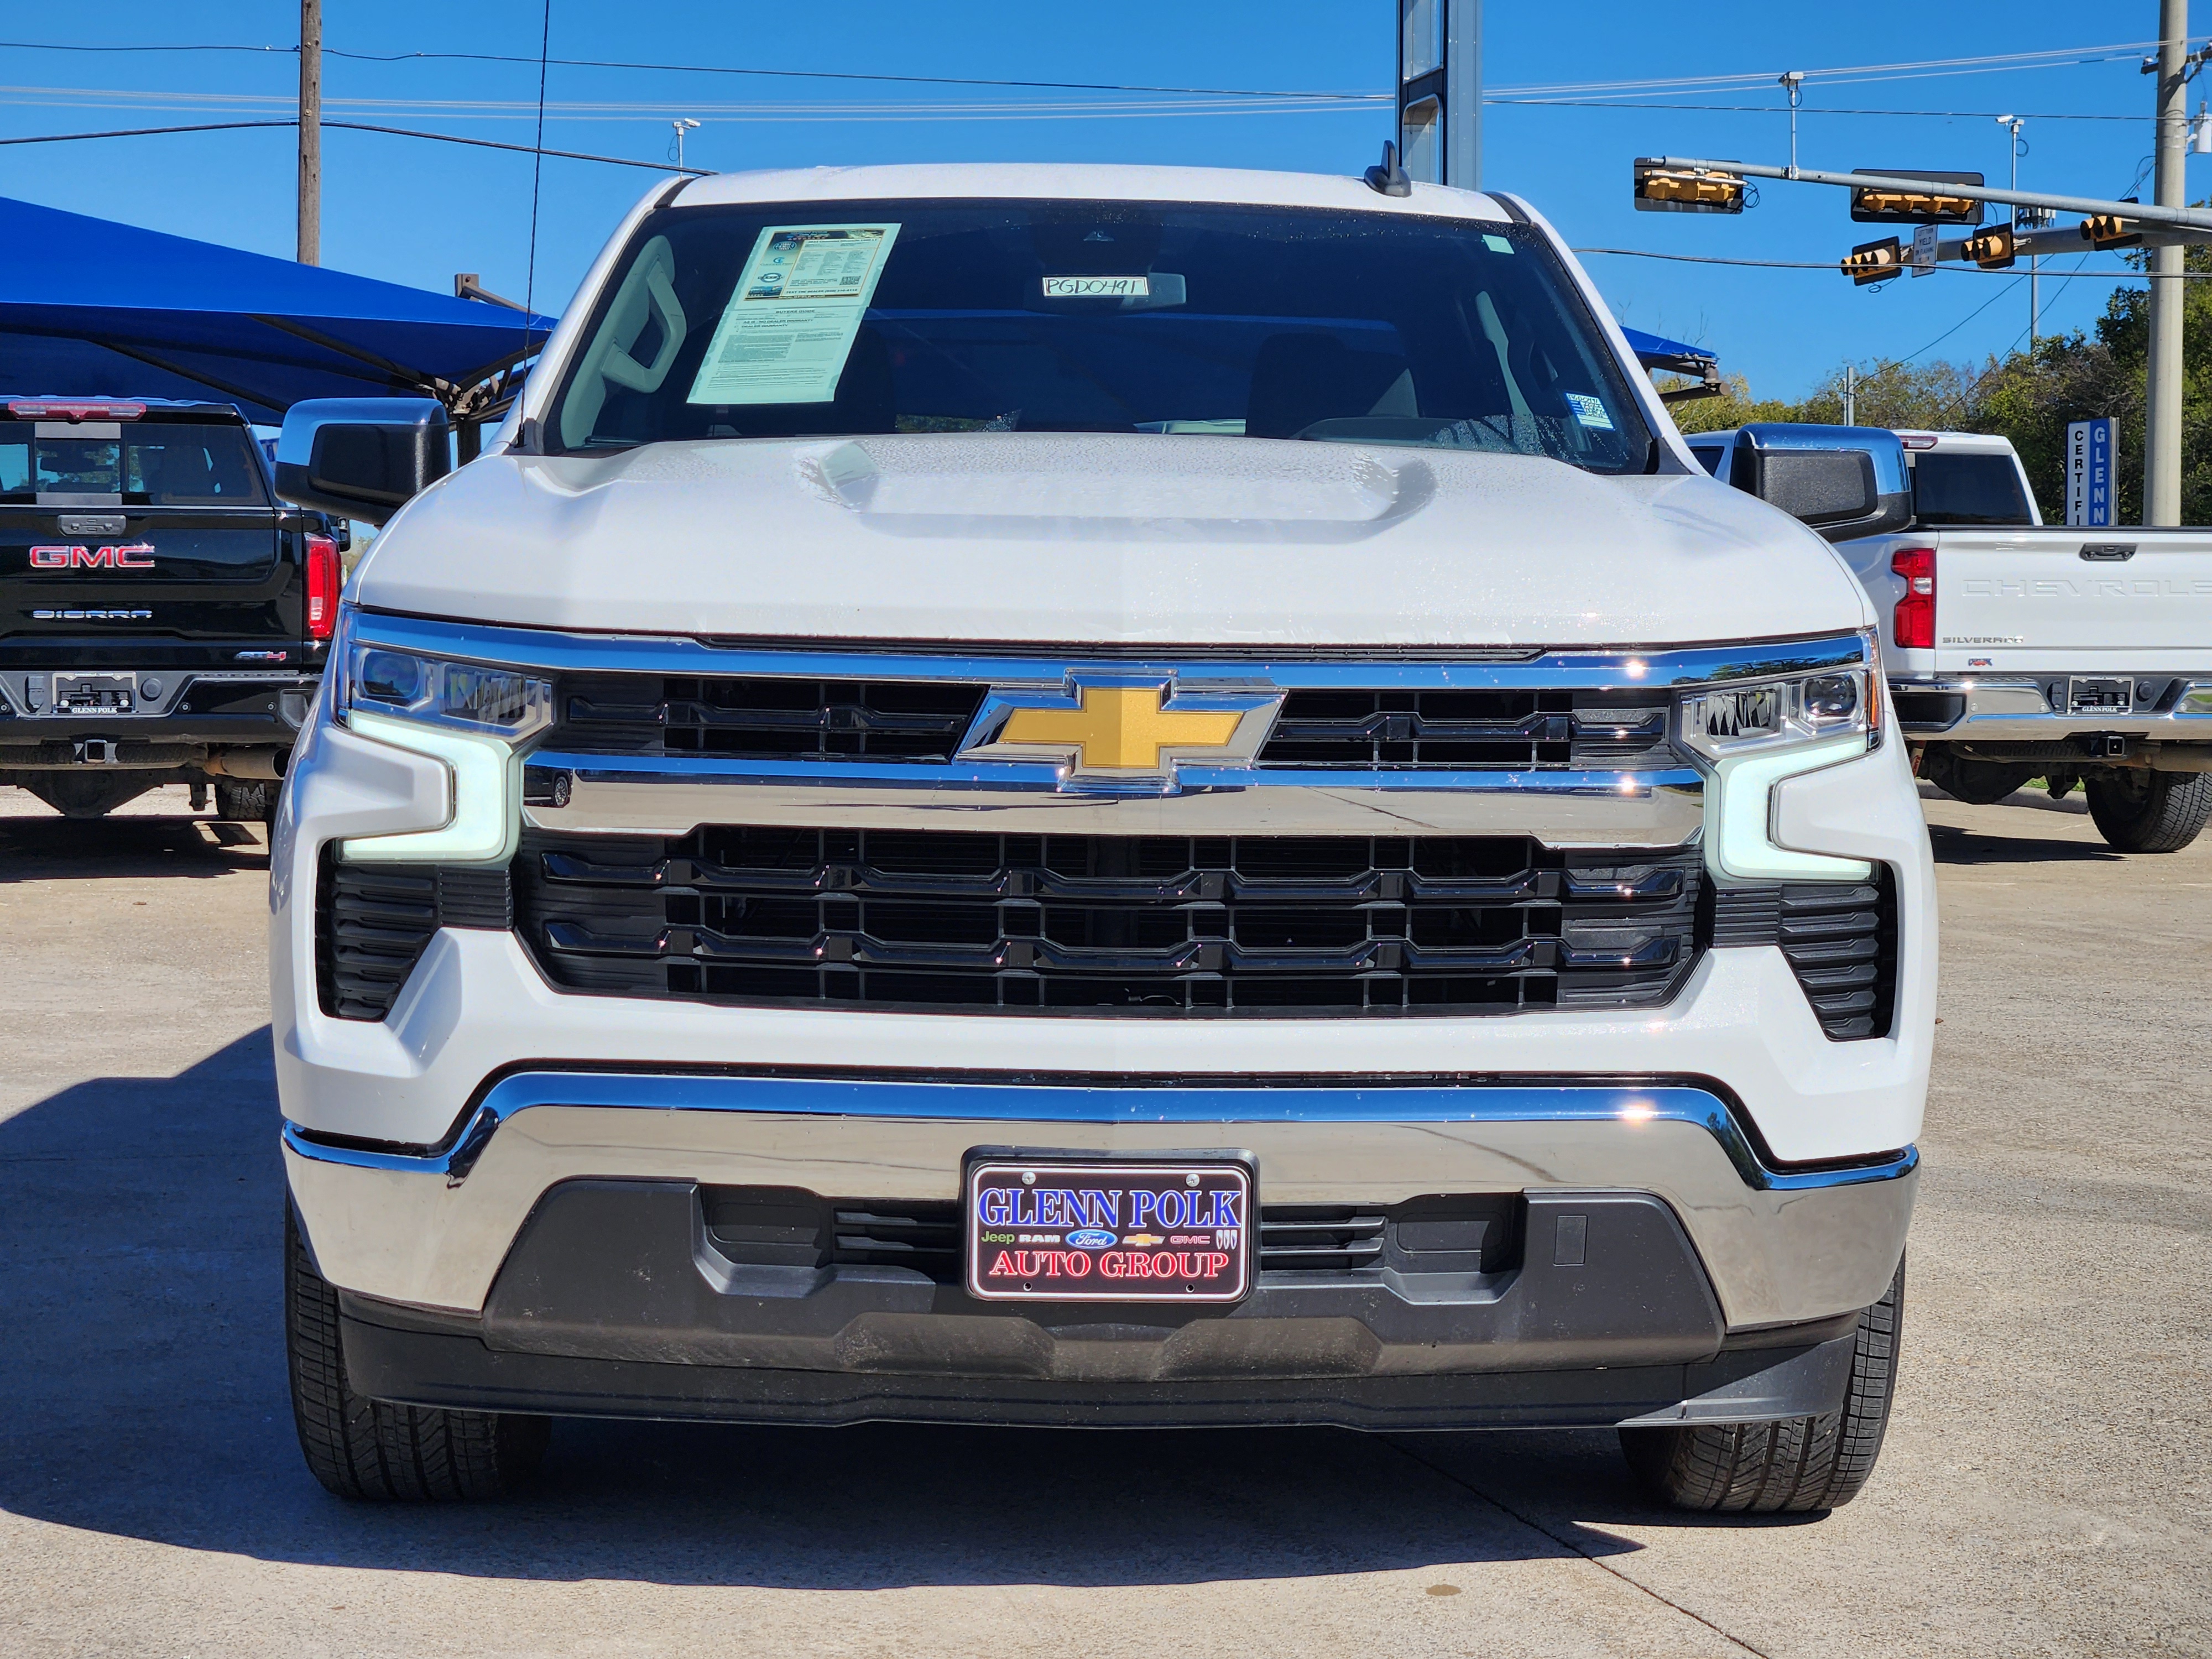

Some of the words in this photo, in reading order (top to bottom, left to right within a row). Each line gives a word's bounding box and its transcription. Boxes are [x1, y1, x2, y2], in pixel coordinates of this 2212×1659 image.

[1919, 237, 1931, 246] YIELD
[2094, 426, 2105, 523] GLENN
[29, 544, 155, 568] GMC
[32, 609, 153, 619] SIERRA
[978, 1188, 1121, 1227] GLENN
[1129, 1190, 1241, 1228] POLK
[981, 1230, 1015, 1244] Jeep
[1019, 1234, 1061, 1243] RAM
[1076, 1232, 1108, 1246] Ford
[1170, 1235, 1211, 1245] GMC
[989, 1250, 1091, 1276] AUTO
[1099, 1251, 1229, 1277] GROUP
